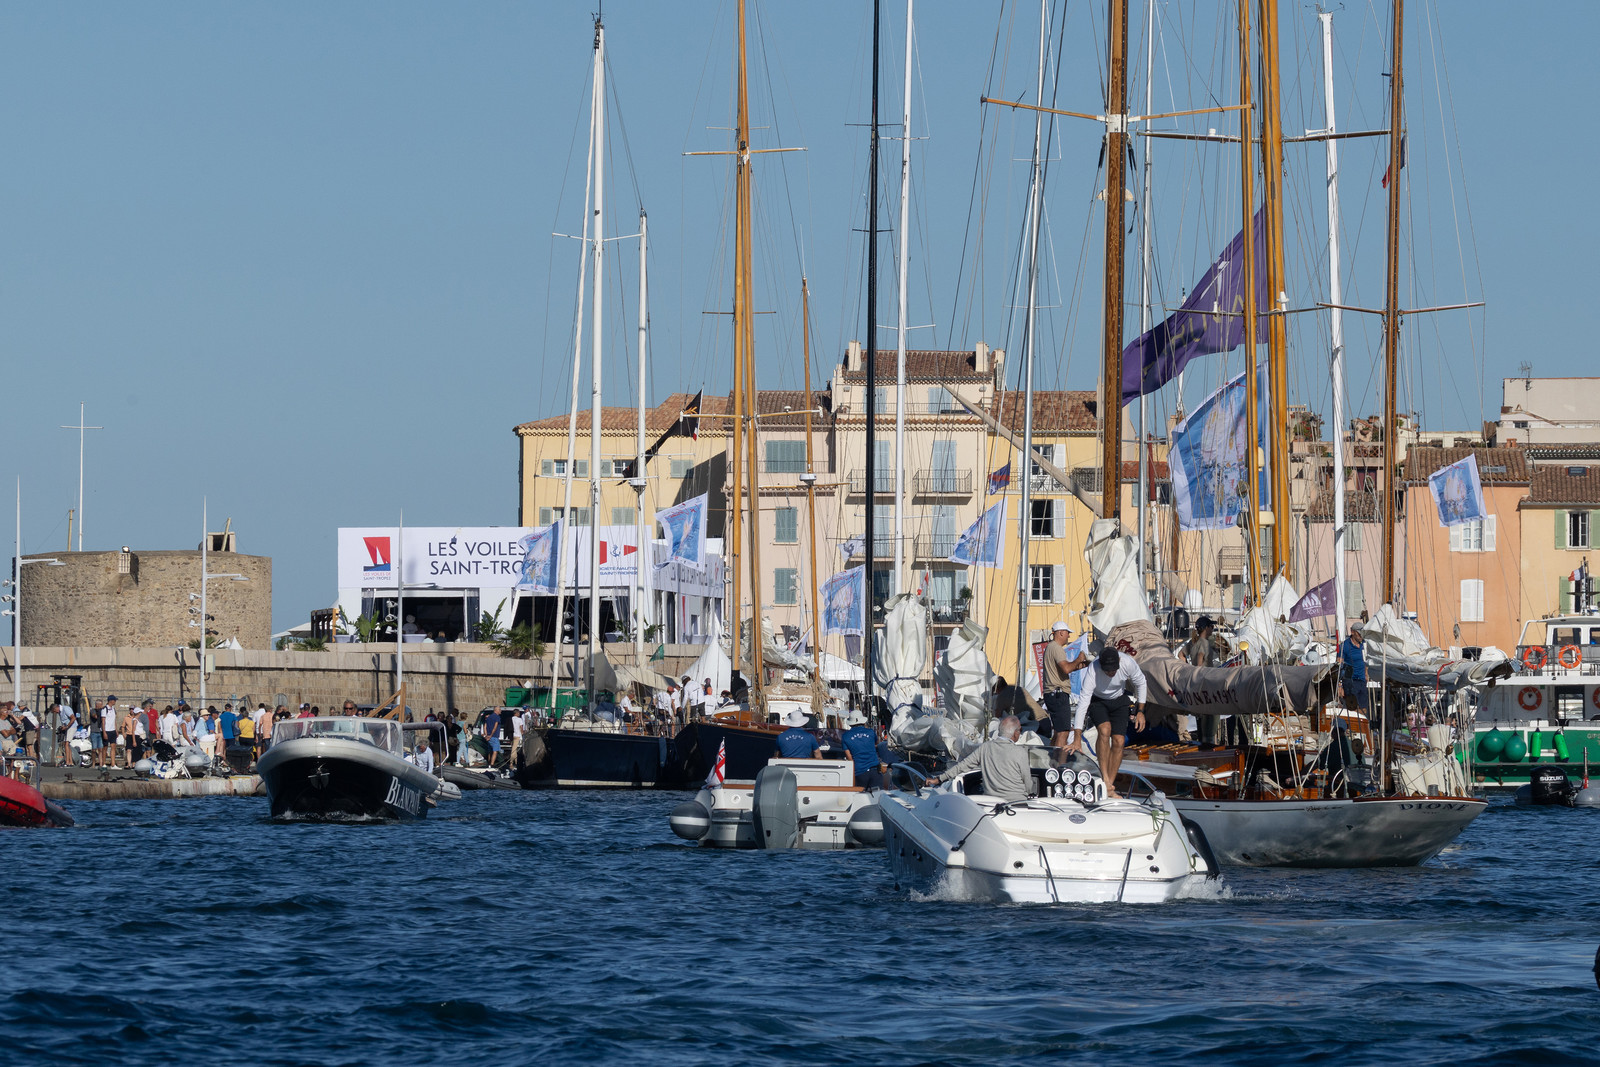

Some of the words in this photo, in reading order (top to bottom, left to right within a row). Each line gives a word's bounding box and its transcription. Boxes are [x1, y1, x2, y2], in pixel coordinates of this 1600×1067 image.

[429, 541, 458, 556] LES
[465, 541, 526, 556] VOILES
[430, 560, 524, 575] SAINT-TRO
[1398, 803, 1469, 811] DIONE
